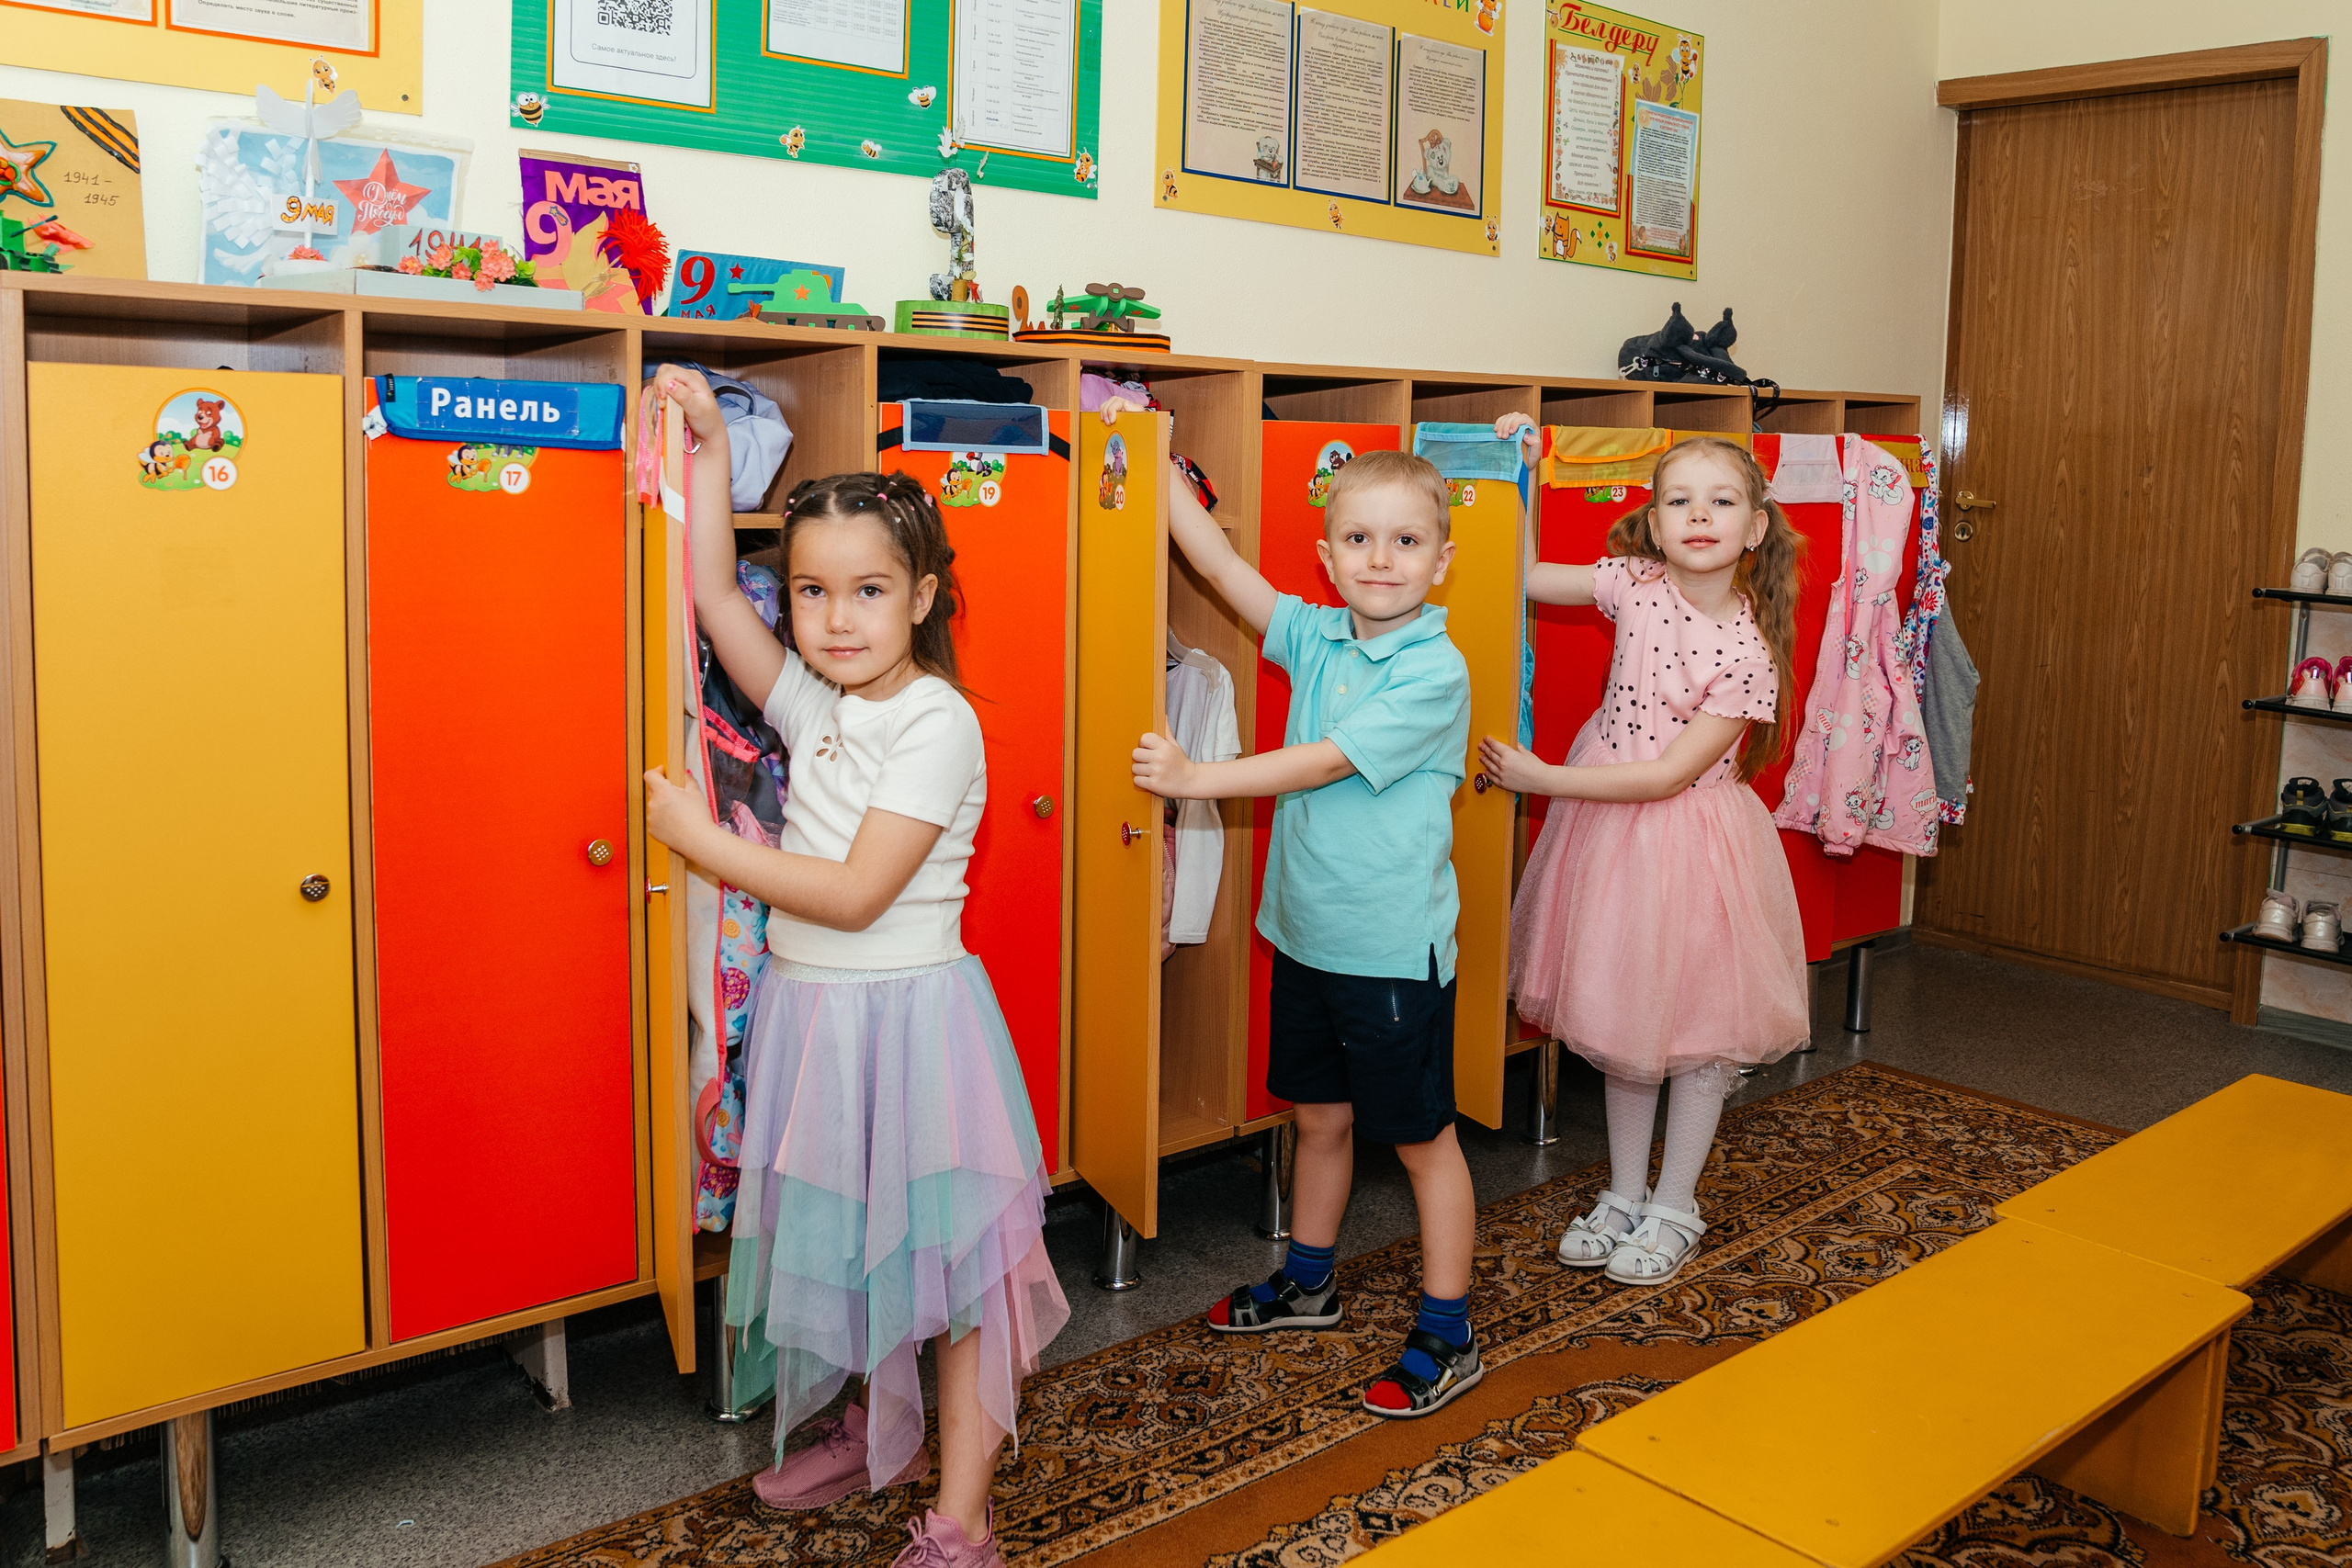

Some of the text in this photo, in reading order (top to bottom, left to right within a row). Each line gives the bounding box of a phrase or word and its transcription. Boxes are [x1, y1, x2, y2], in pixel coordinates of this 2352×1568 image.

[198, 0, 234, 8] Определять
[592, 43, 676, 63] Самое актуальное здесь!
[545, 170, 640, 210] Мая
[85, 193, 120, 206] 1945
[280, 196, 334, 226] 9 МАЯ
[526, 201, 572, 267] 9
[680, 256, 715, 305] 9
[431, 387, 561, 423] Ранель
[209, 466, 229, 482] 16
[506, 471, 521, 486] 17
[982, 487, 995, 500] 19
[1116, 491, 1124, 504] 20
[1464, 490, 1474, 502] 22
[1612, 486, 1624, 498] 23
